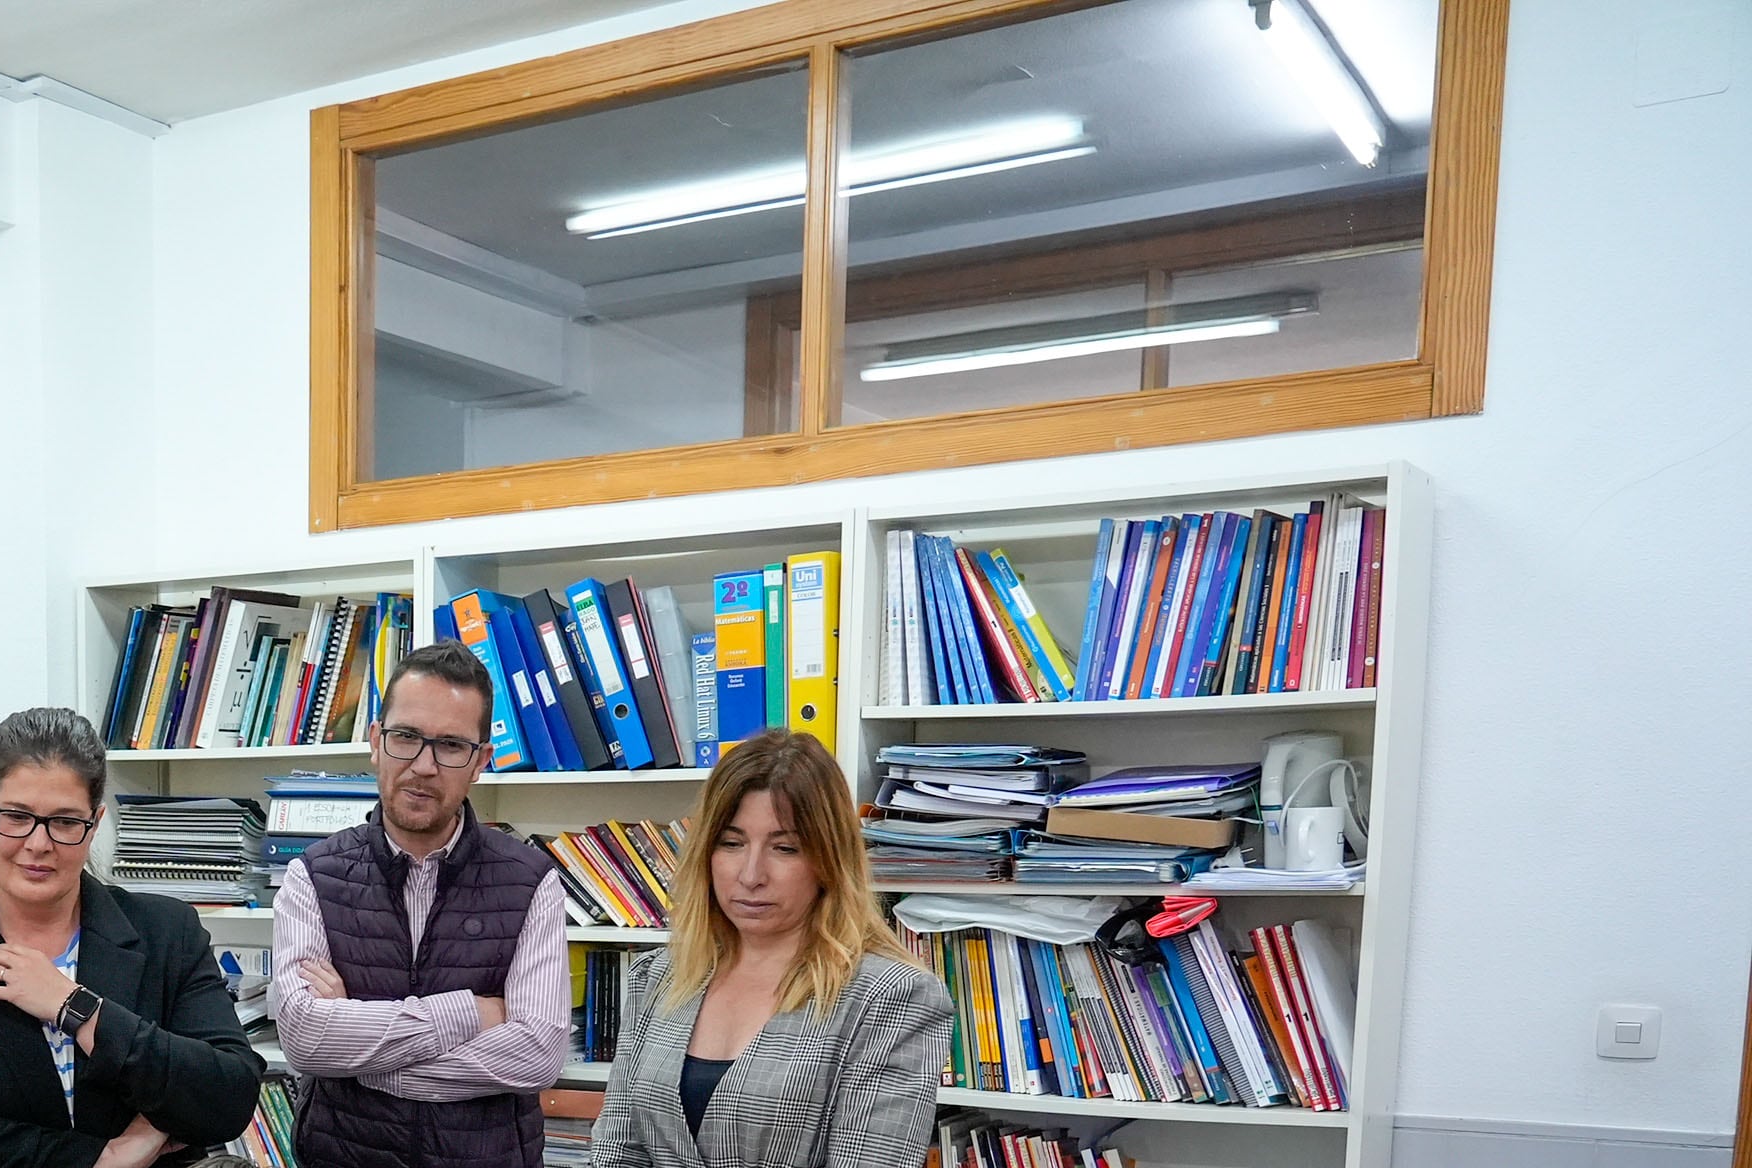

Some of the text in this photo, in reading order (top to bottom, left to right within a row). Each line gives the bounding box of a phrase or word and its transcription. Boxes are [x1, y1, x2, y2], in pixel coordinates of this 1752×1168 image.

[796, 569, 817, 583] Uni
[721, 580, 748, 603] 2º
[1261, 588, 1269, 606] Sociales
[715, 614, 755, 626] Matemáticas
[1258, 606, 1267, 624] Ciencias
[1254, 635, 1263, 655] aplicadas
[695, 654, 715, 673] Red
[1249, 655, 1260, 683] Matemáticas
[695, 677, 715, 697] Hat
[696, 699, 716, 729] Linux
